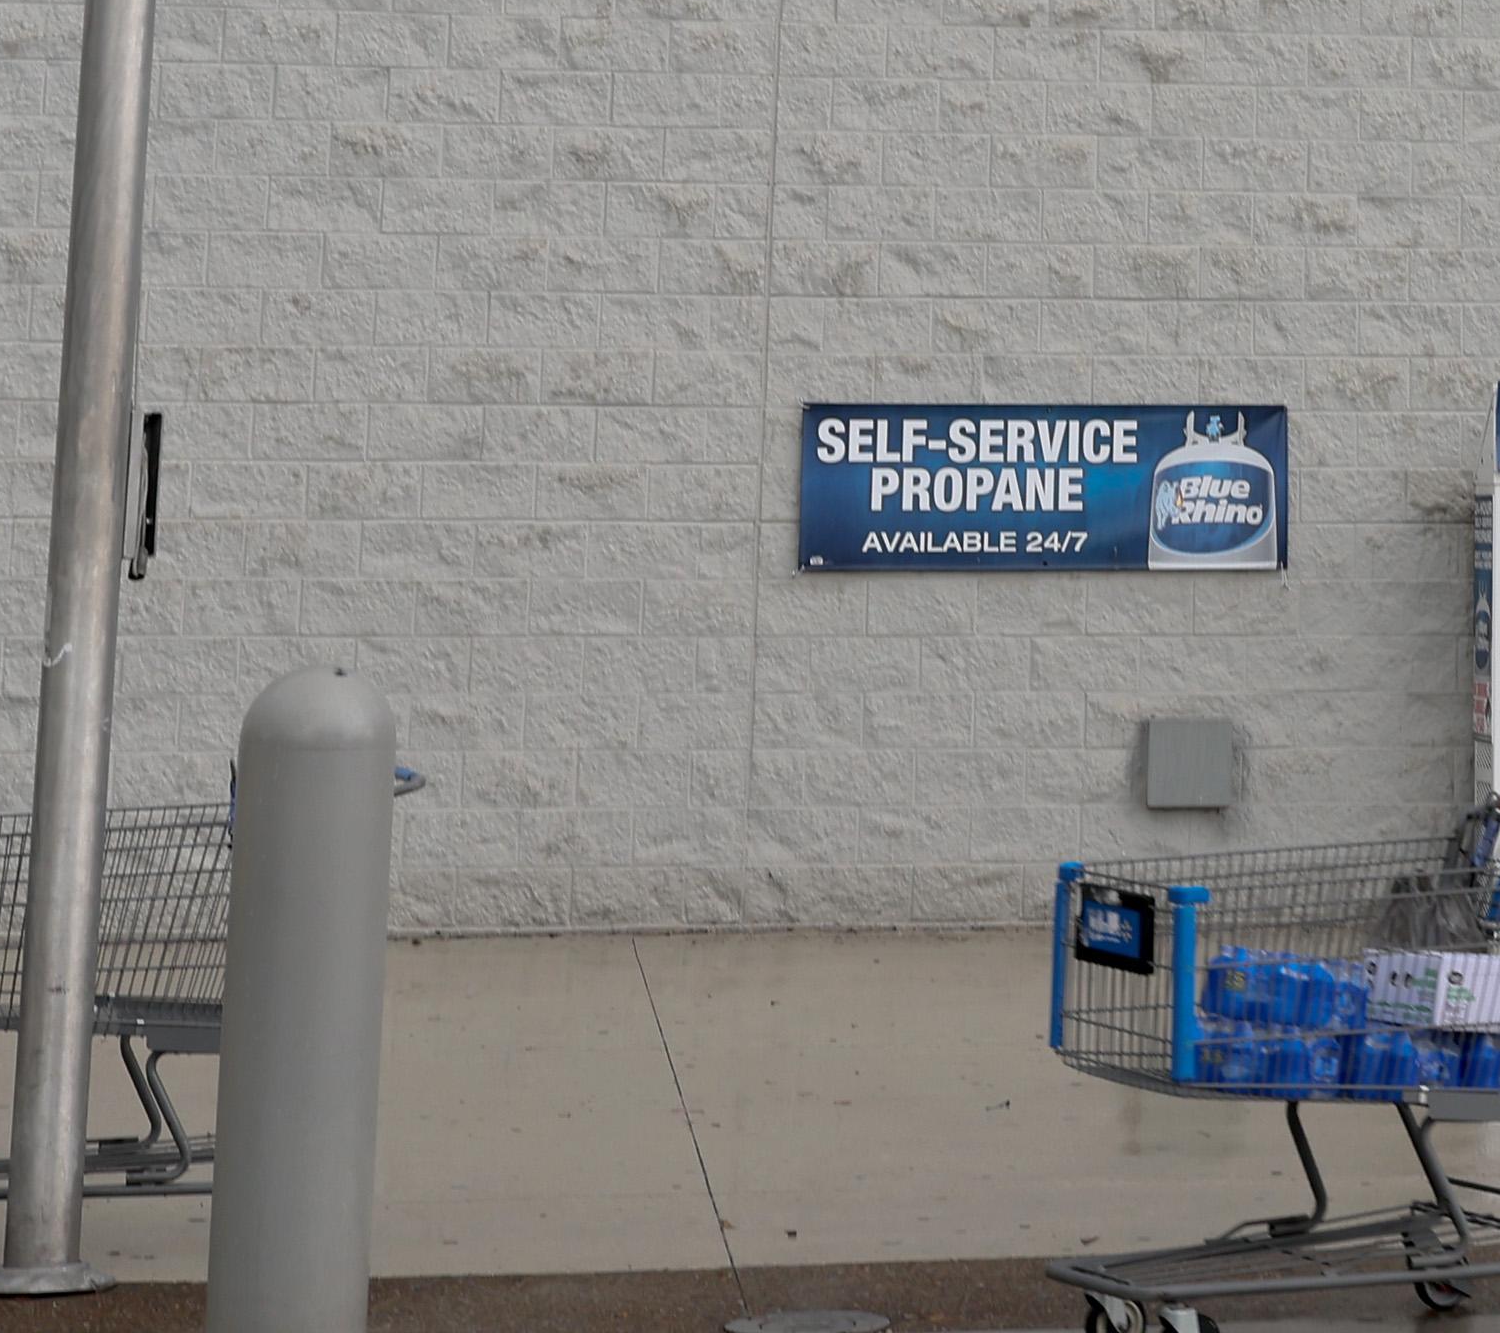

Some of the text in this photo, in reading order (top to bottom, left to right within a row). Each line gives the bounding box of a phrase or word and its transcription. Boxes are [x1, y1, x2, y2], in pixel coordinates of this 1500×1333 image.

[817, 418, 1138, 463] SELF-SERVICE
[870, 468, 1084, 512] PROPANE
[1178, 476, 1251, 500] Blue
[1172, 496, 1263, 526] Rhino
[862, 531, 1088, 554] AVAILABLE 24/7
